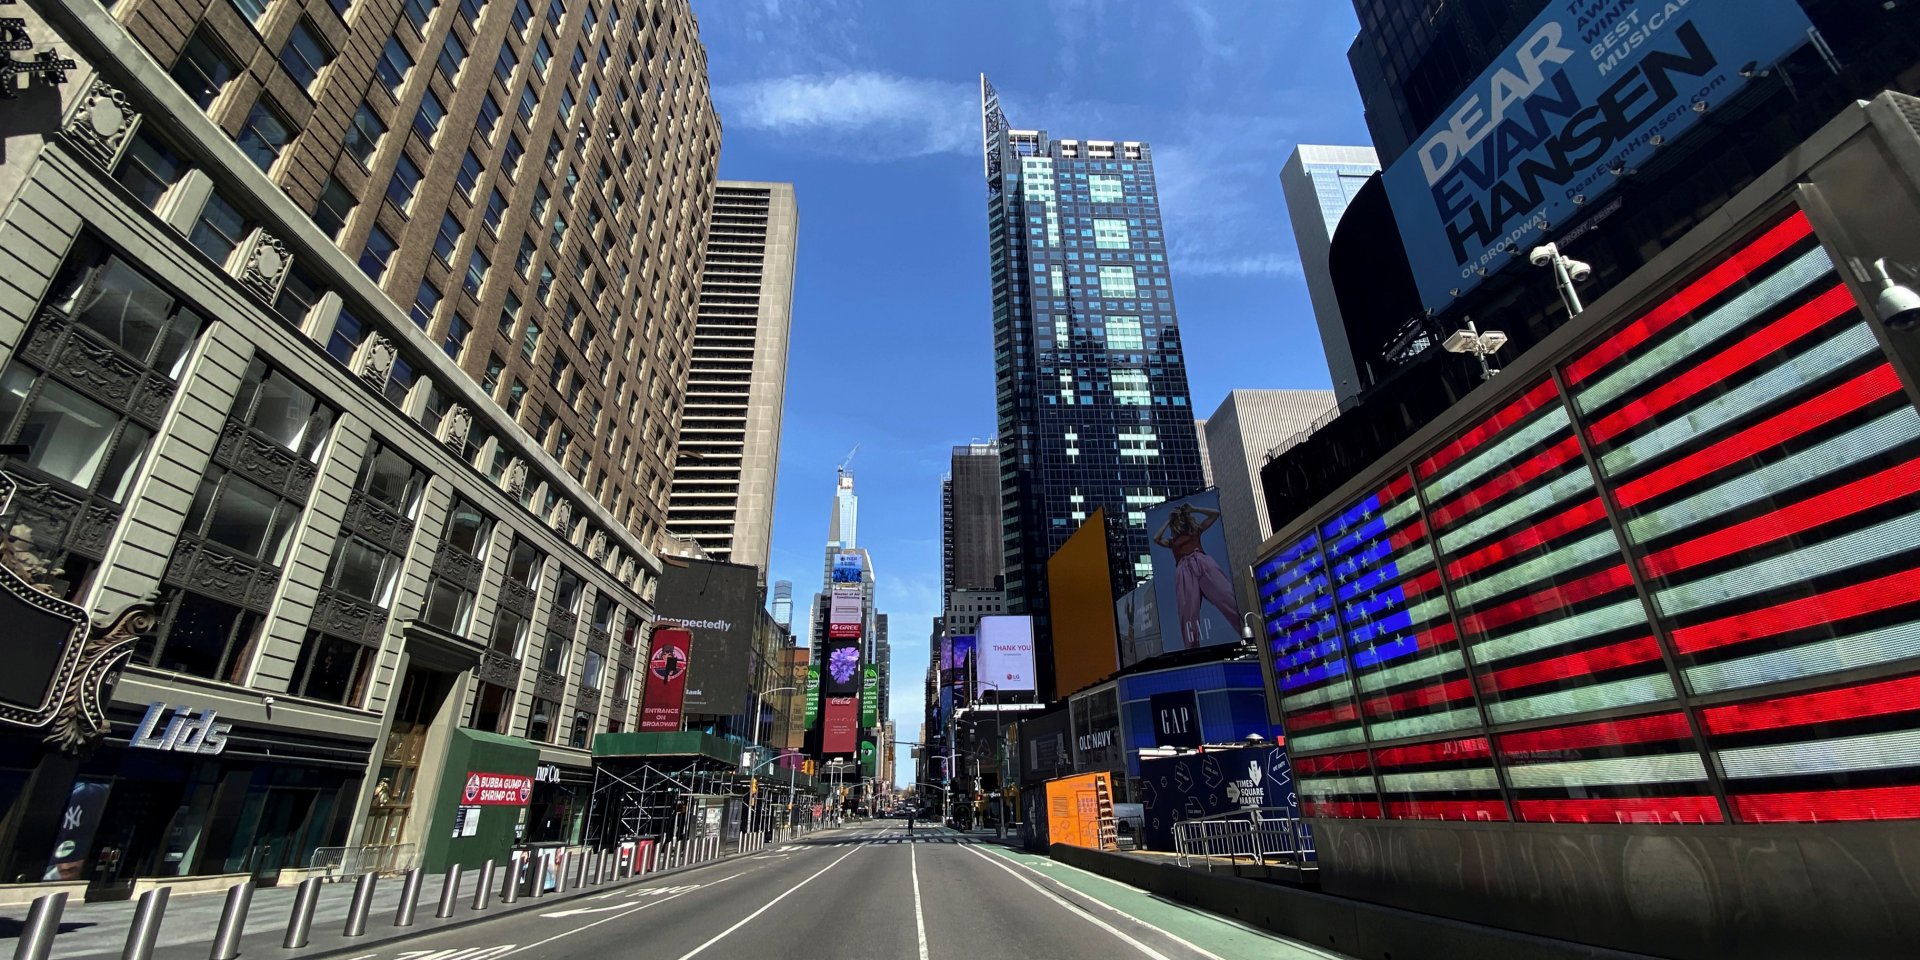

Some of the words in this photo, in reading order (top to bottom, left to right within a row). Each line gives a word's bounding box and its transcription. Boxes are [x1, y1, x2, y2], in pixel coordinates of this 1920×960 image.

[1590, 8, 1639, 61] BEST
[1417, 21, 1576, 187] DEAR
[1430, 68, 1582, 225] EVAN
[1444, 19, 1718, 267] HANSEN
[1565, 73, 1727, 199] DearEvanHansen.com
[1461, 262, 1479, 279] ON
[1480, 207, 1548, 266] BROADWAY
[1186, 618, 1211, 642] GAP
[129, 701, 232, 755] Lids
[1161, 707, 1189, 735] GAP
[1079, 734, 1091, 751] OLD
[1092, 730, 1111, 750] NAVY
[480, 777, 502, 789] BUBBA
[503, 778, 522, 789] GUMP
[480, 790, 505, 801] SHRIMP
[505, 791, 517, 802] CO.
[1236, 780, 1254, 788] TIMES
[1240, 787, 1265, 796] SQUARE
[1239, 796, 1264, 805] MARKET
